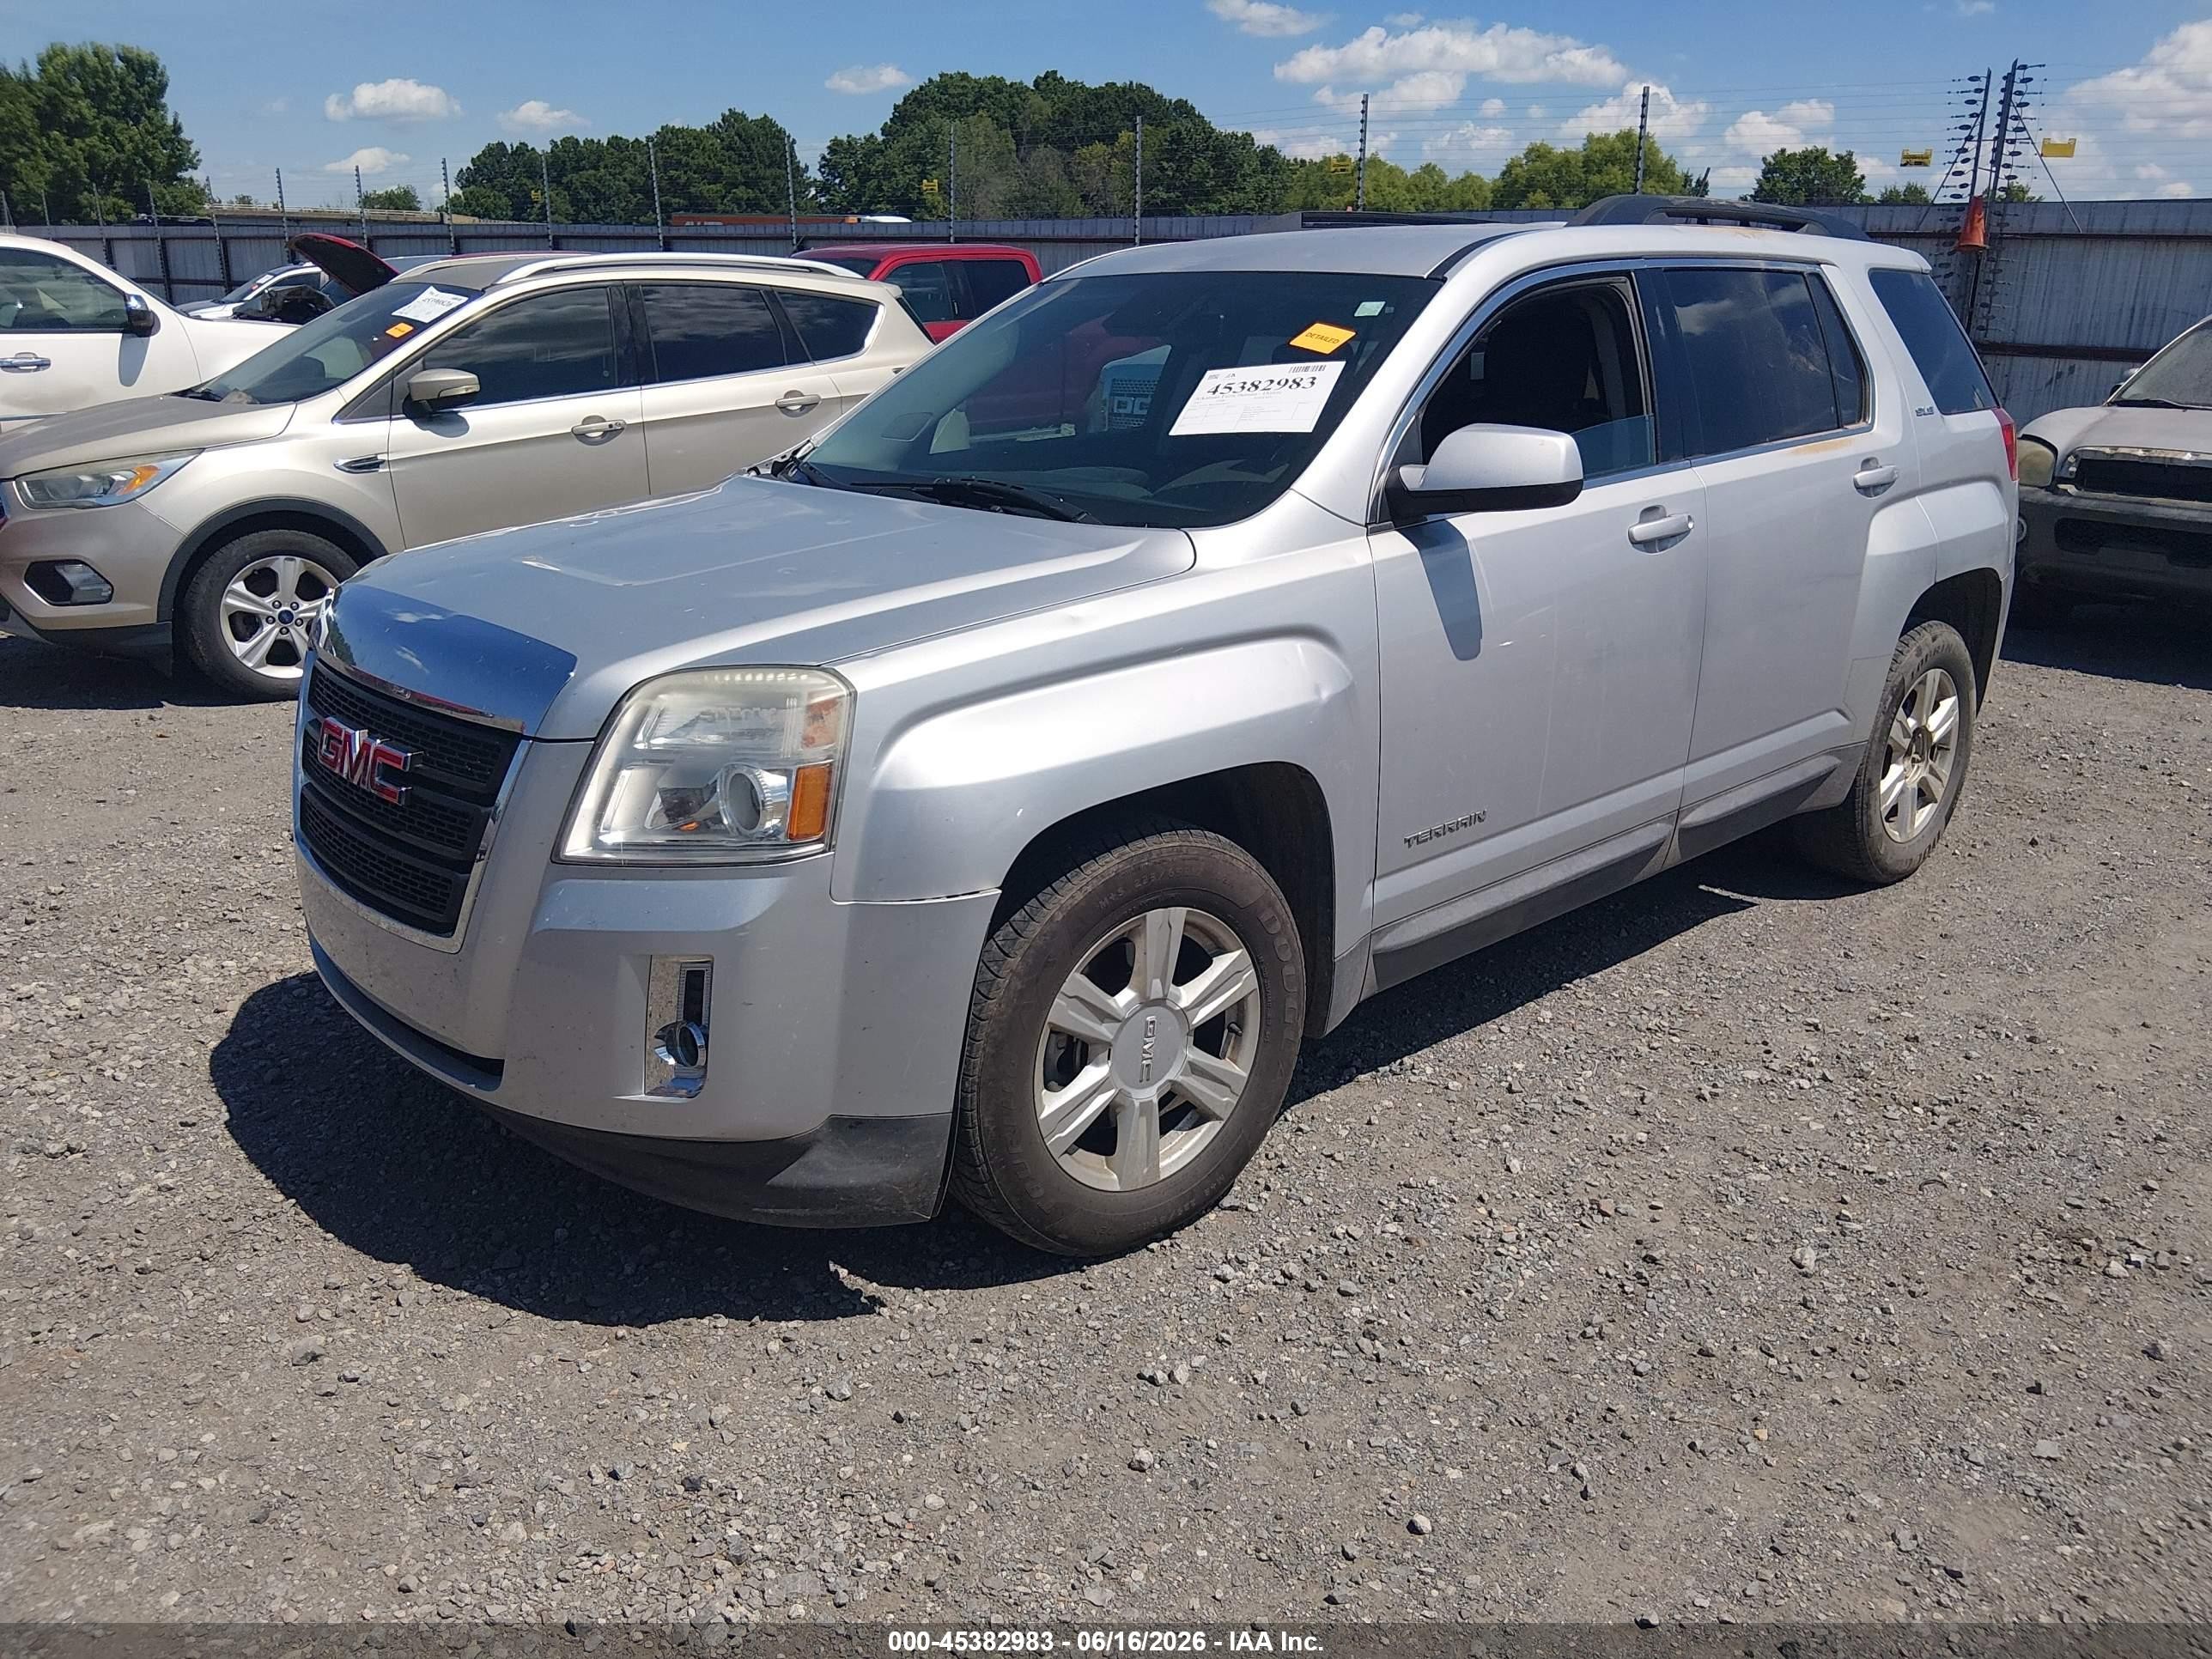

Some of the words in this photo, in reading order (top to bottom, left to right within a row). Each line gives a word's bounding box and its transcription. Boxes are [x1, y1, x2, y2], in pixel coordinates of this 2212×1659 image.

[1305, 332, 1340, 344] DETAILED
[1206, 375, 1318, 396] 45382983
[318, 716, 411, 806] GMC
[1403, 808, 1488, 849] TERRAIN
[1139, 1015, 1158, 1083] GMC
